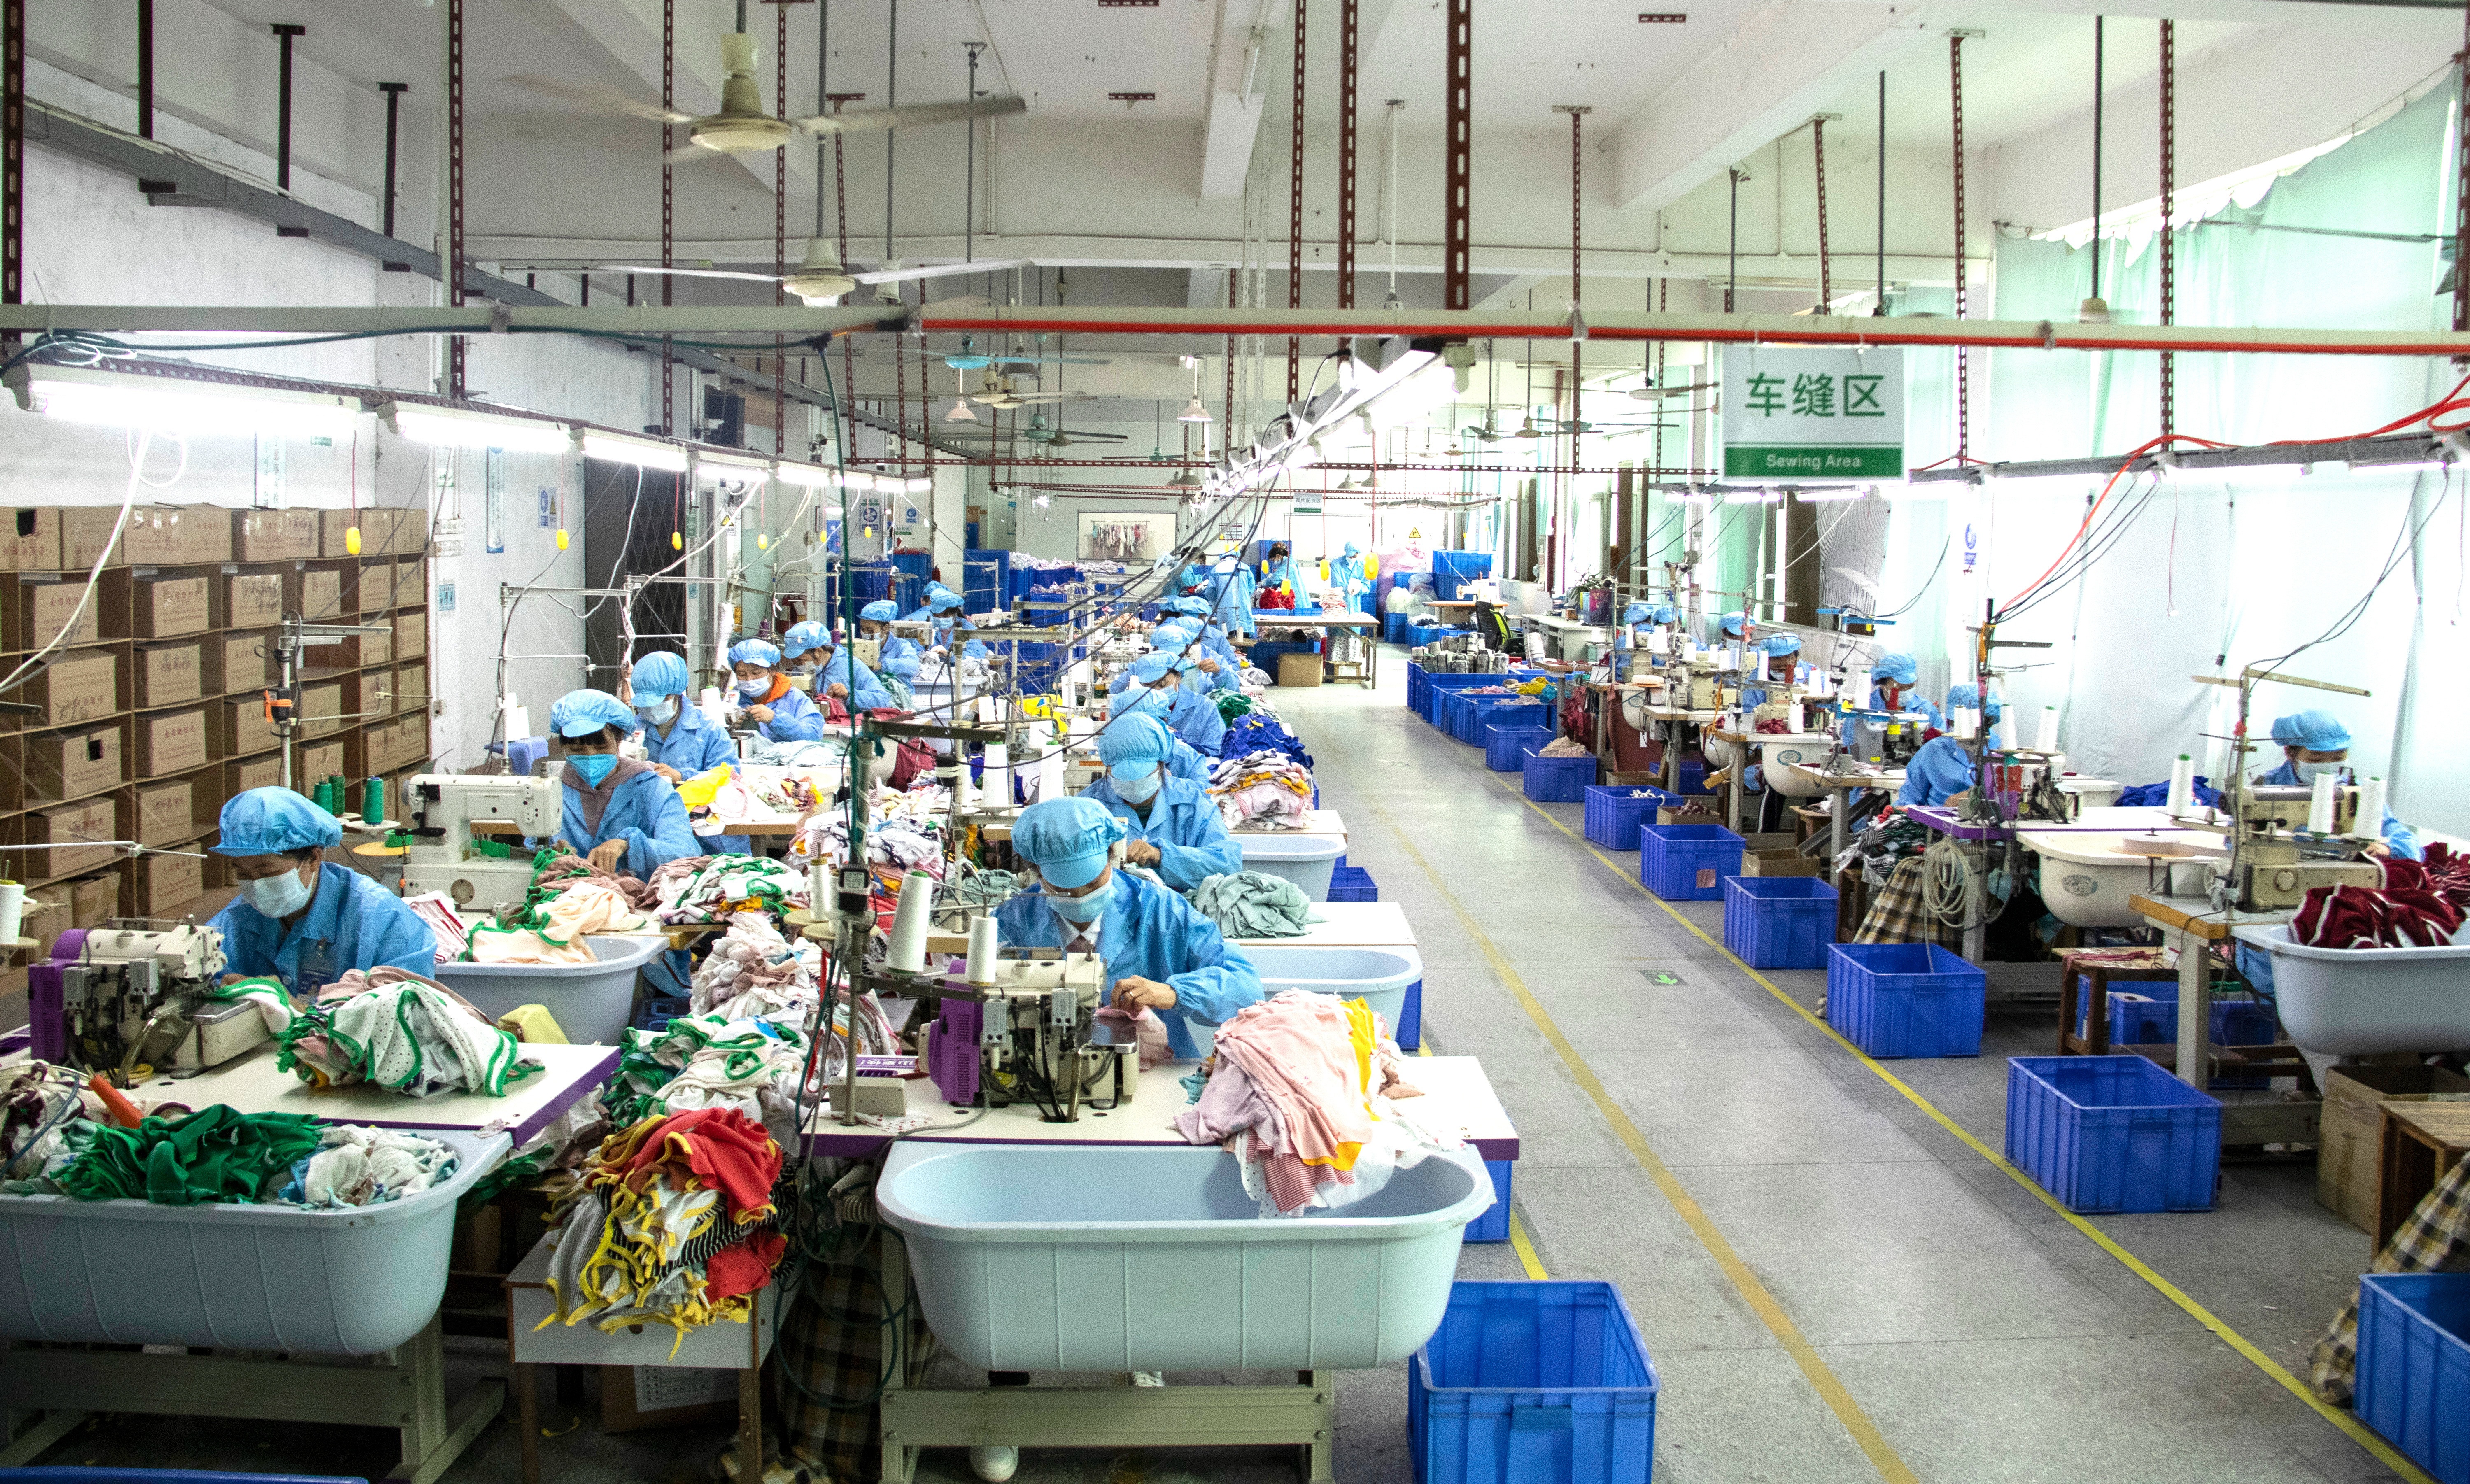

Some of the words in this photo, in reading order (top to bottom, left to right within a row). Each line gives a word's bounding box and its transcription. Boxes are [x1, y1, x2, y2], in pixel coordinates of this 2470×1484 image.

[1746, 372, 1885, 417] 车缝区
[1766, 454, 1821, 470] Sewing
[1825, 454, 1861, 467] Area
